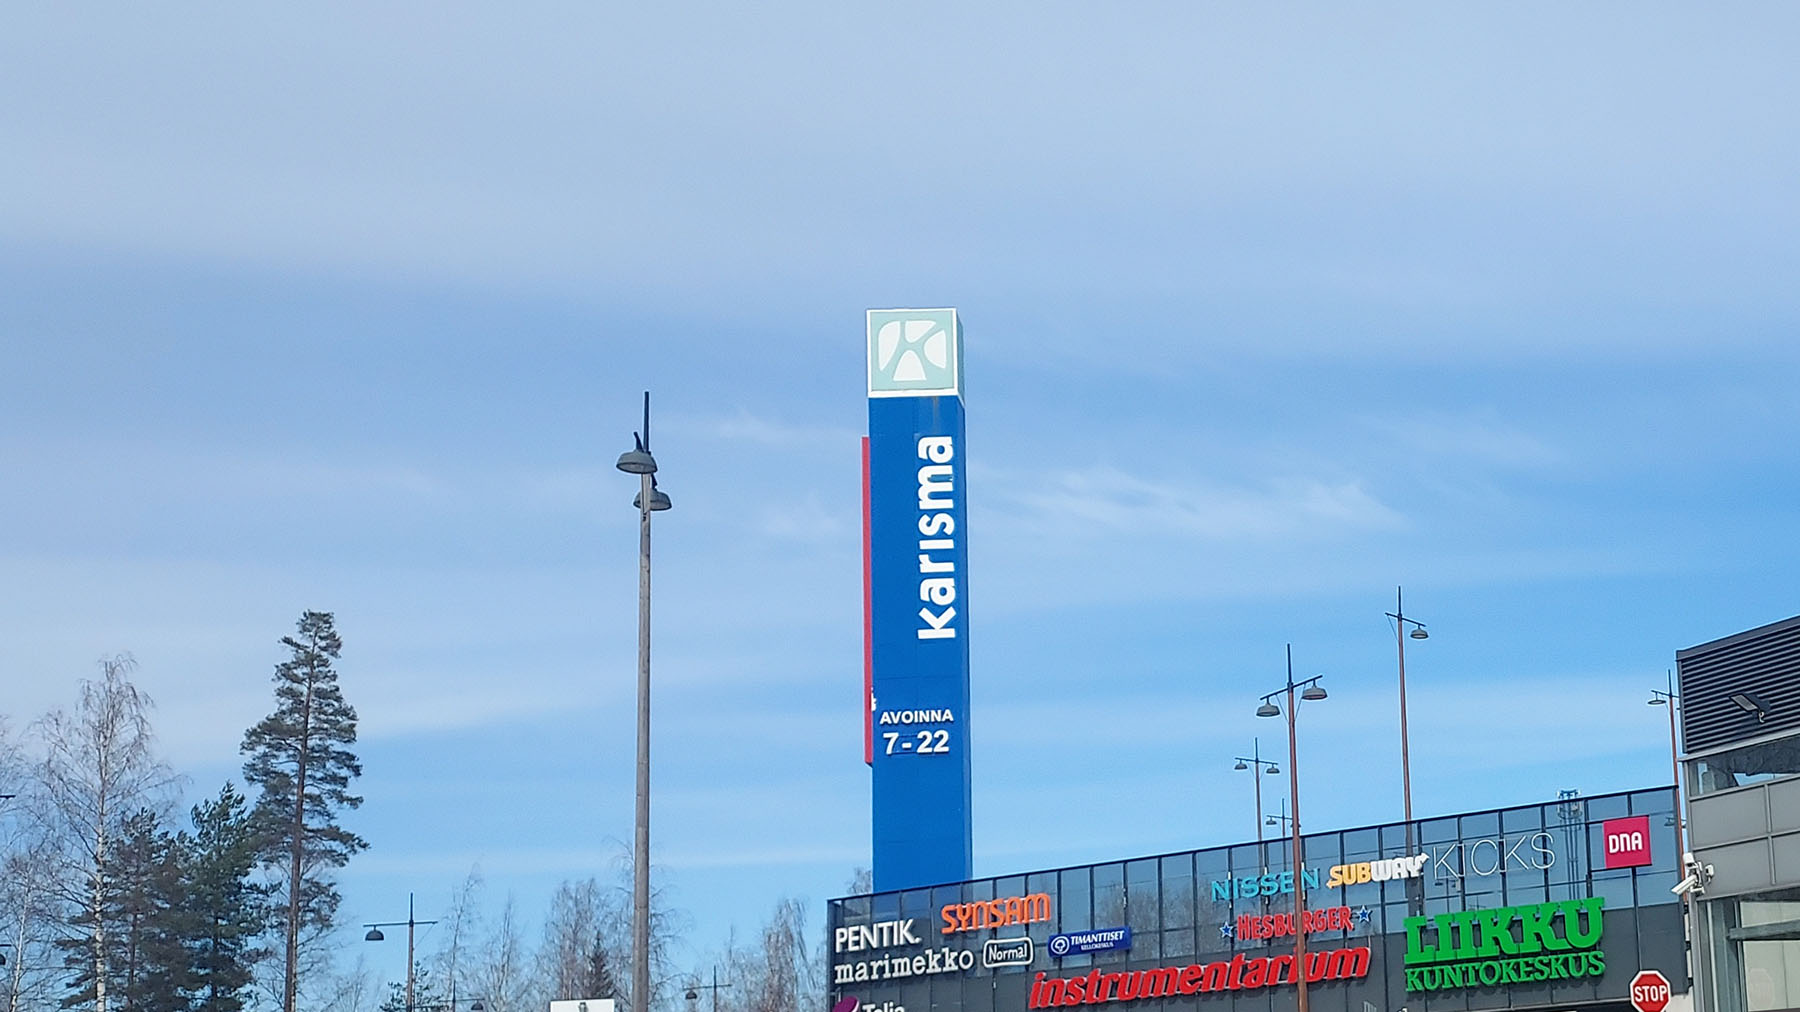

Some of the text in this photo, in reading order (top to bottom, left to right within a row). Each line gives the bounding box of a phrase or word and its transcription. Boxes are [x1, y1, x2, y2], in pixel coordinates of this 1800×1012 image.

[917, 436, 956, 639] karisma
[880, 709, 954, 725] AVOINNA
[883, 732, 899, 755] 7
[917, 730, 949, 753] 22
[1433, 833, 1556, 880] KICKS
[1608, 832, 1643, 854] DNA
[1211, 868, 1321, 901] NISSEN
[1326, 852, 1430, 889] SUBWAY
[941, 893, 1050, 934] SYNSAM
[1237, 906, 1354, 940] HESBURGER
[1404, 897, 1605, 963] LIIKKU
[988, 943, 1028, 963] Normal
[1070, 930, 1125, 946] TIMANTTISET
[835, 948, 974, 984] marimekko
[1028, 947, 1371, 1010] instrumentarium
[1405, 951, 1605, 992] KUNTOKESKUS
[861, 1001, 905, 1012] Tlia
[1633, 985, 1668, 1003] STOP
